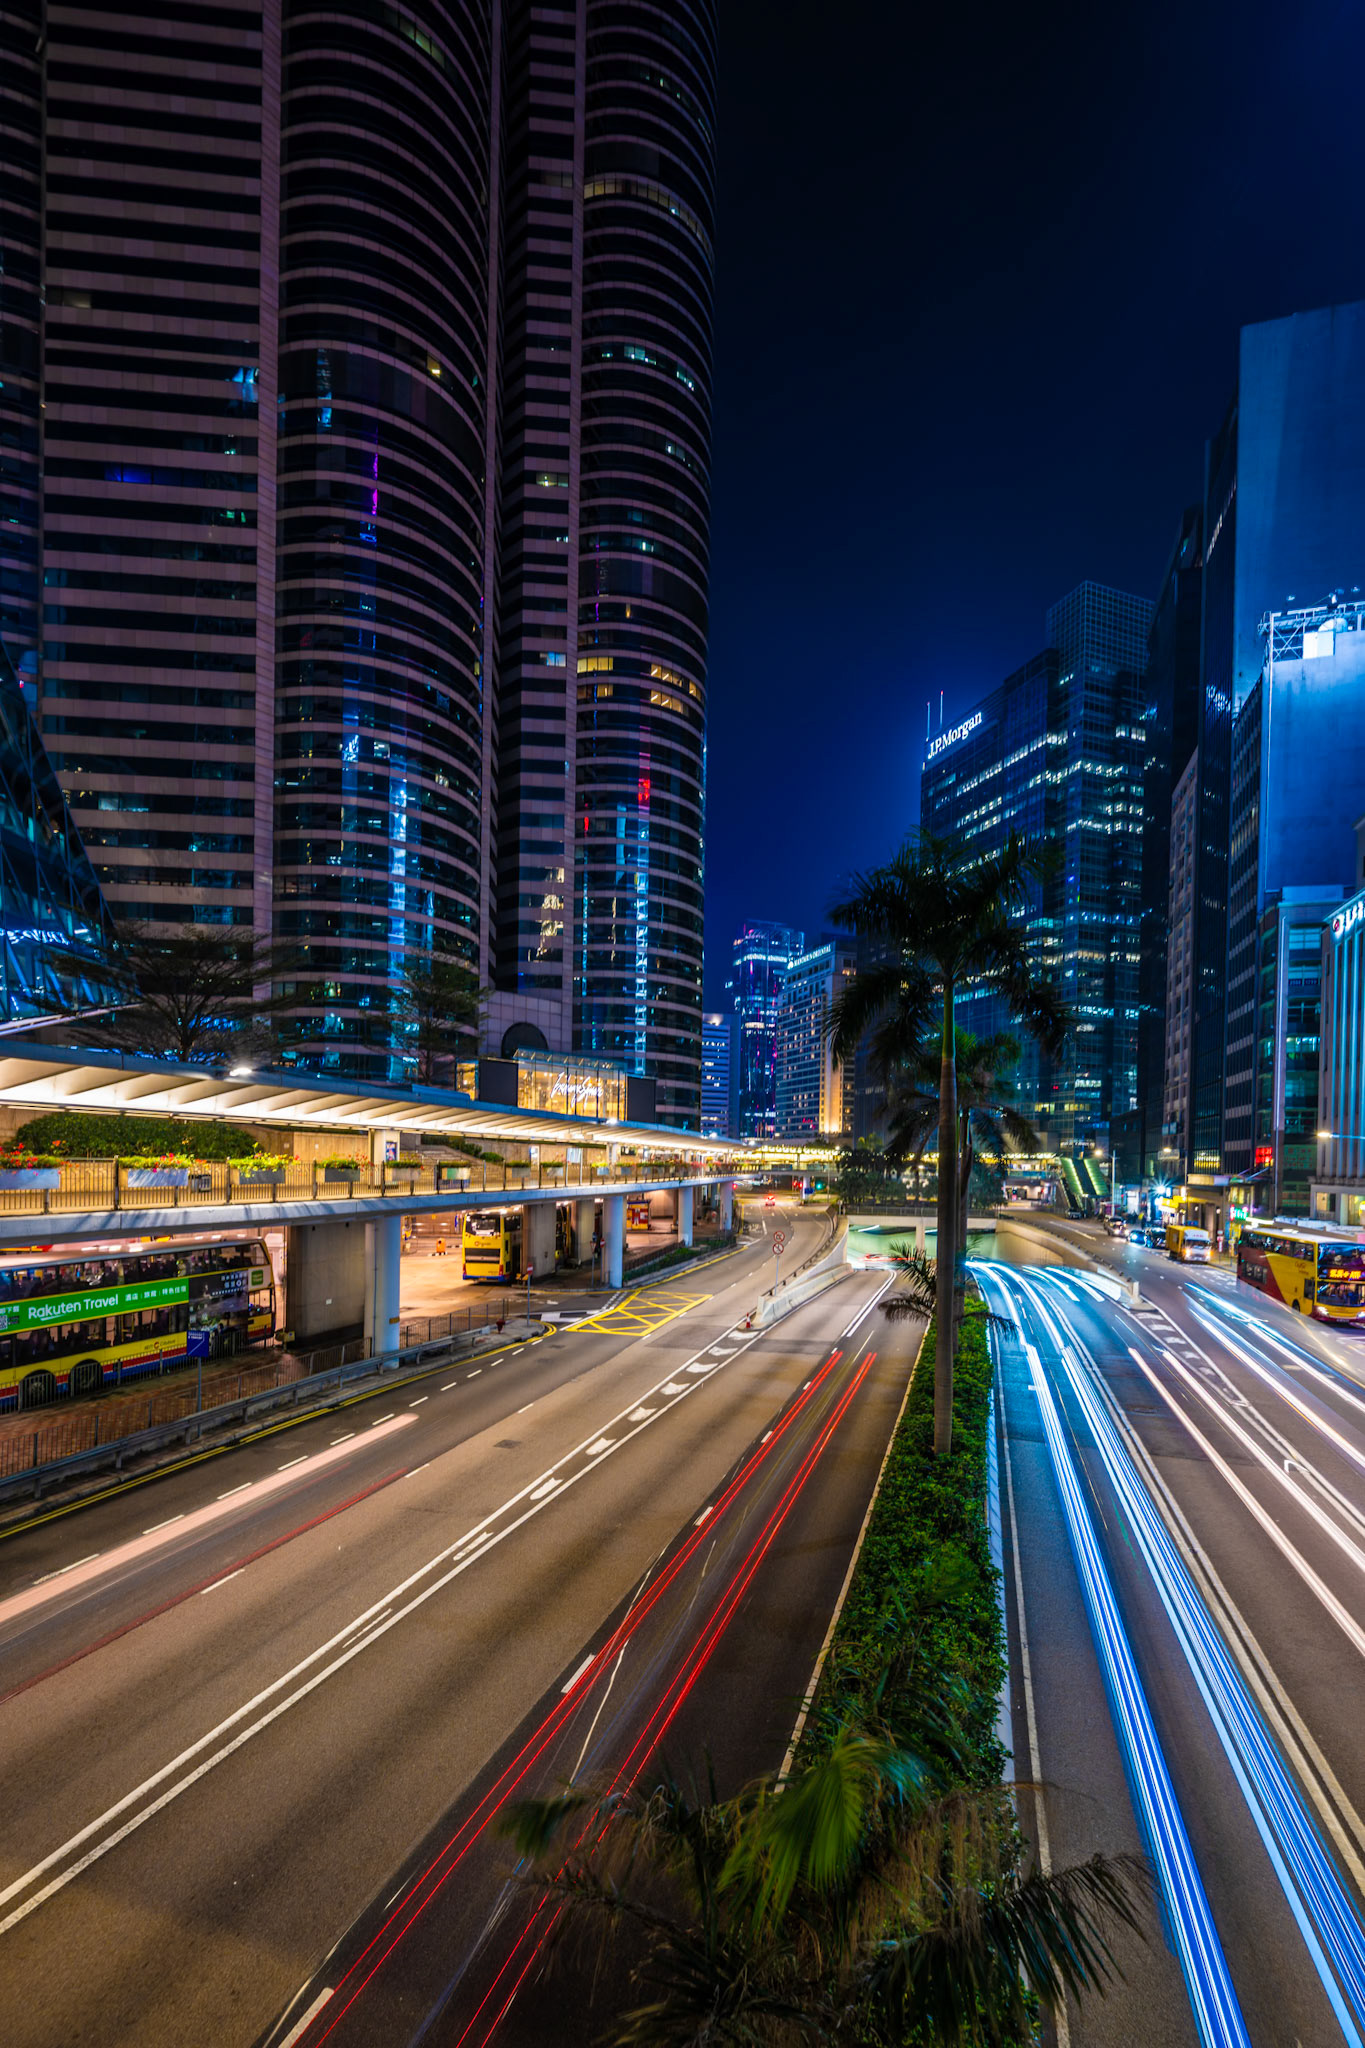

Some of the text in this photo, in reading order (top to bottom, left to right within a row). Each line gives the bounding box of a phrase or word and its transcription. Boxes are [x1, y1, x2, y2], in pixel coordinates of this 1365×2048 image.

[928, 712, 982, 760] J.P.Morgan
[28, 1301, 81, 1320] Rakuten
[83, 1294, 118, 1310] Travel
